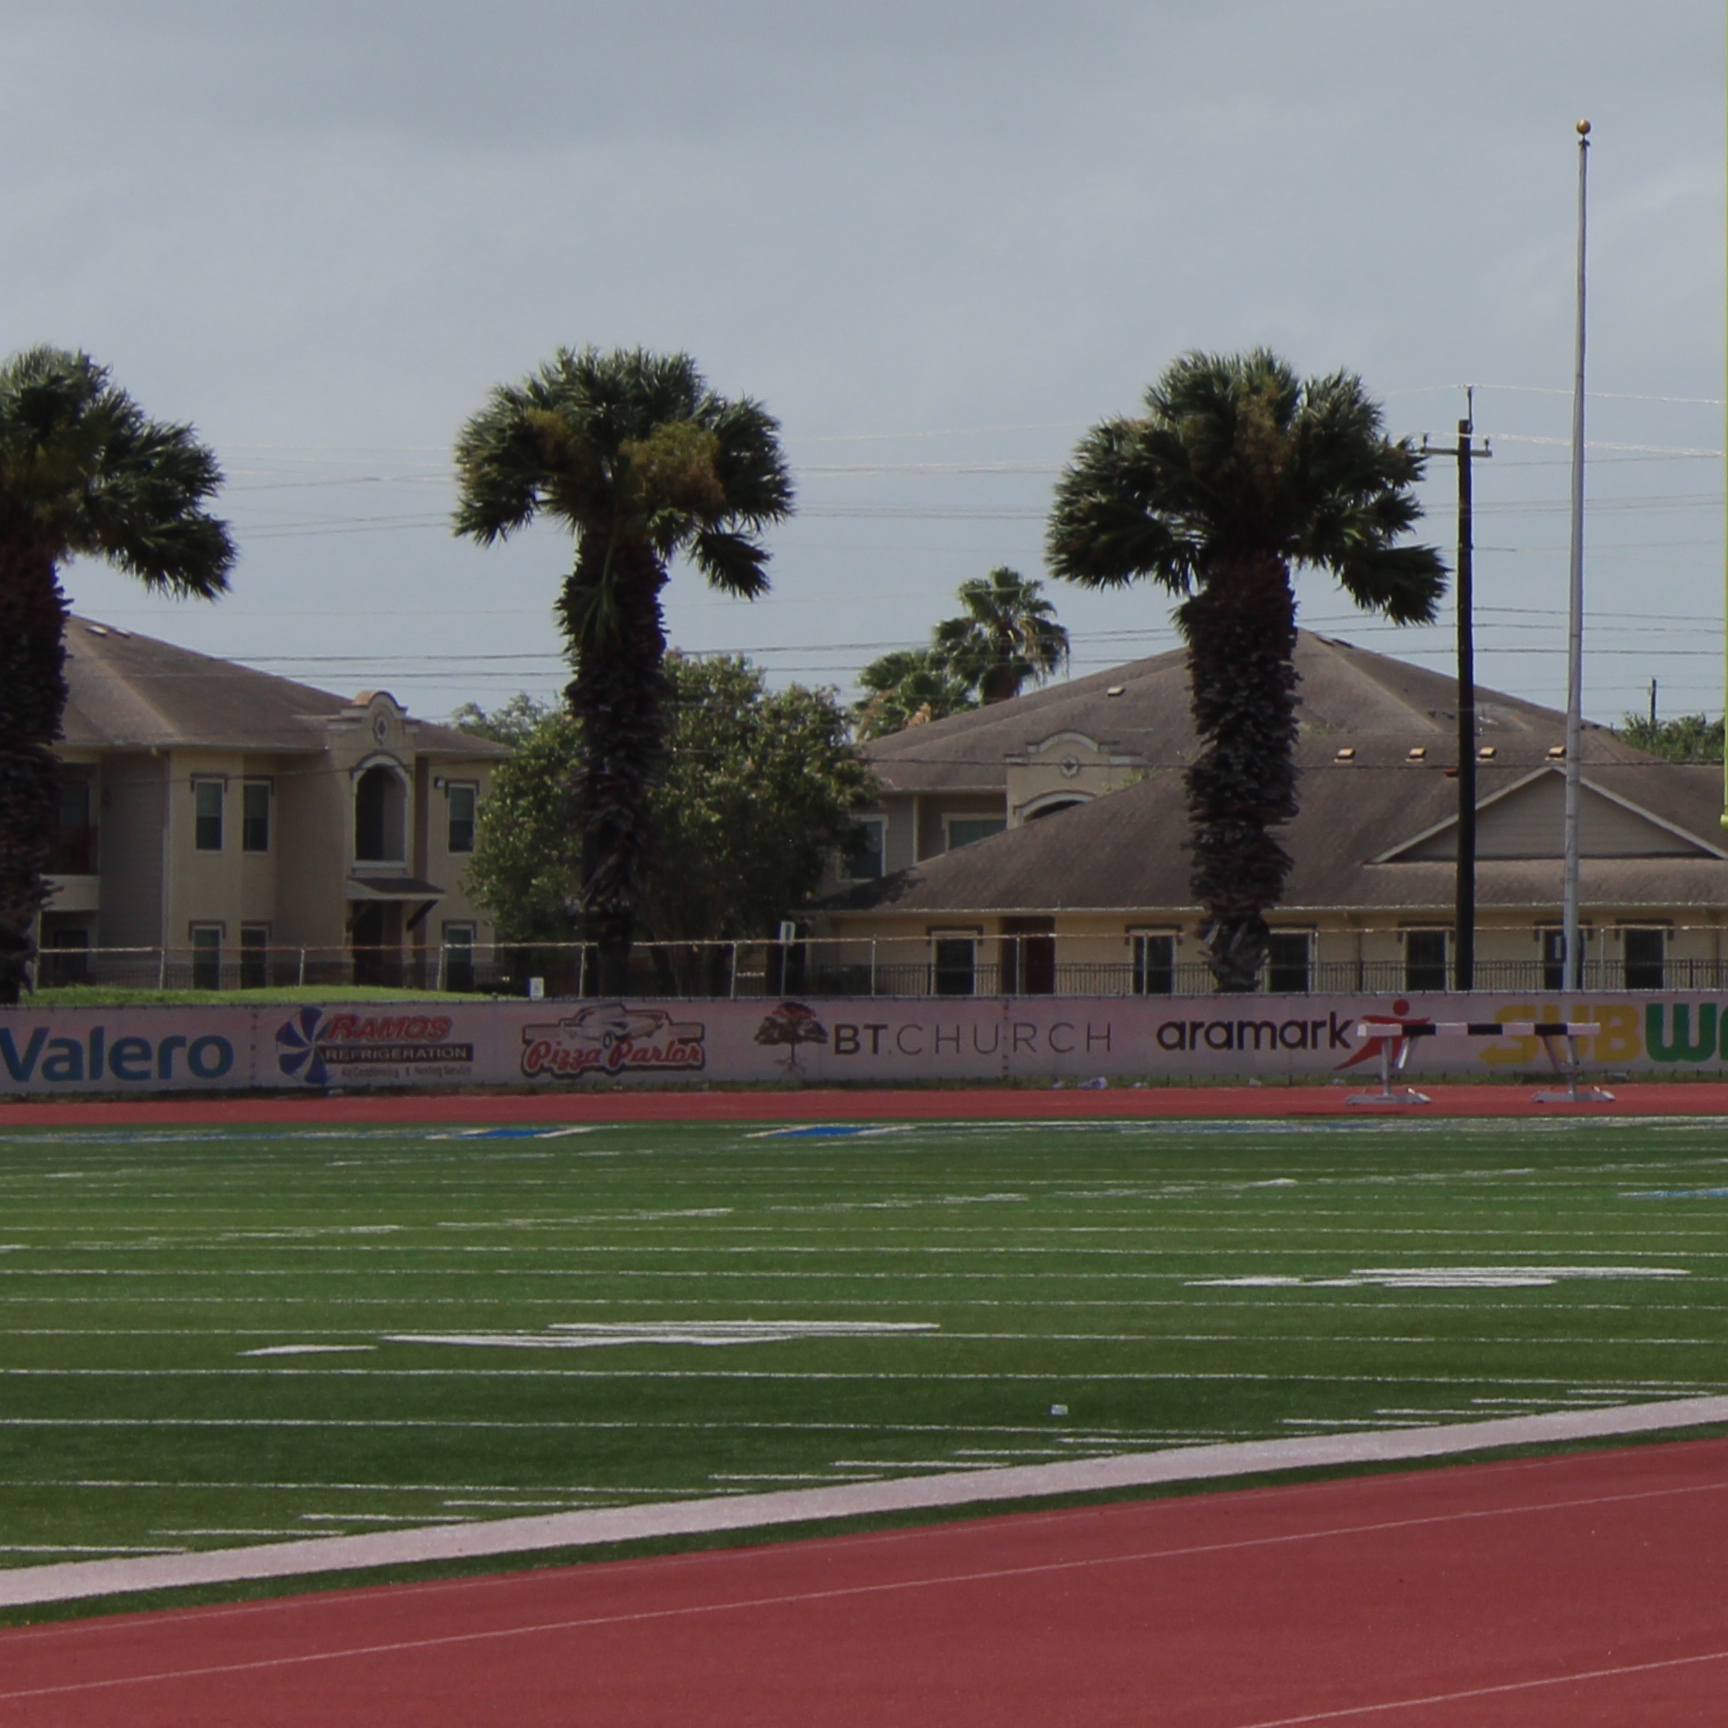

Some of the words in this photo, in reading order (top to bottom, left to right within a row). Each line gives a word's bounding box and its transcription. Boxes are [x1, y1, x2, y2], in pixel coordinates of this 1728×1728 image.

[326, 1013, 454, 1042] RAMOS
[1156, 1011, 1353, 1051] aramark
[0, 1025, 235, 1083] Valero
[324, 1046, 468, 1061] REFRIGERATION
[526, 1040, 601, 1071] Pizza
[607, 1038, 701, 1068] Parlor
